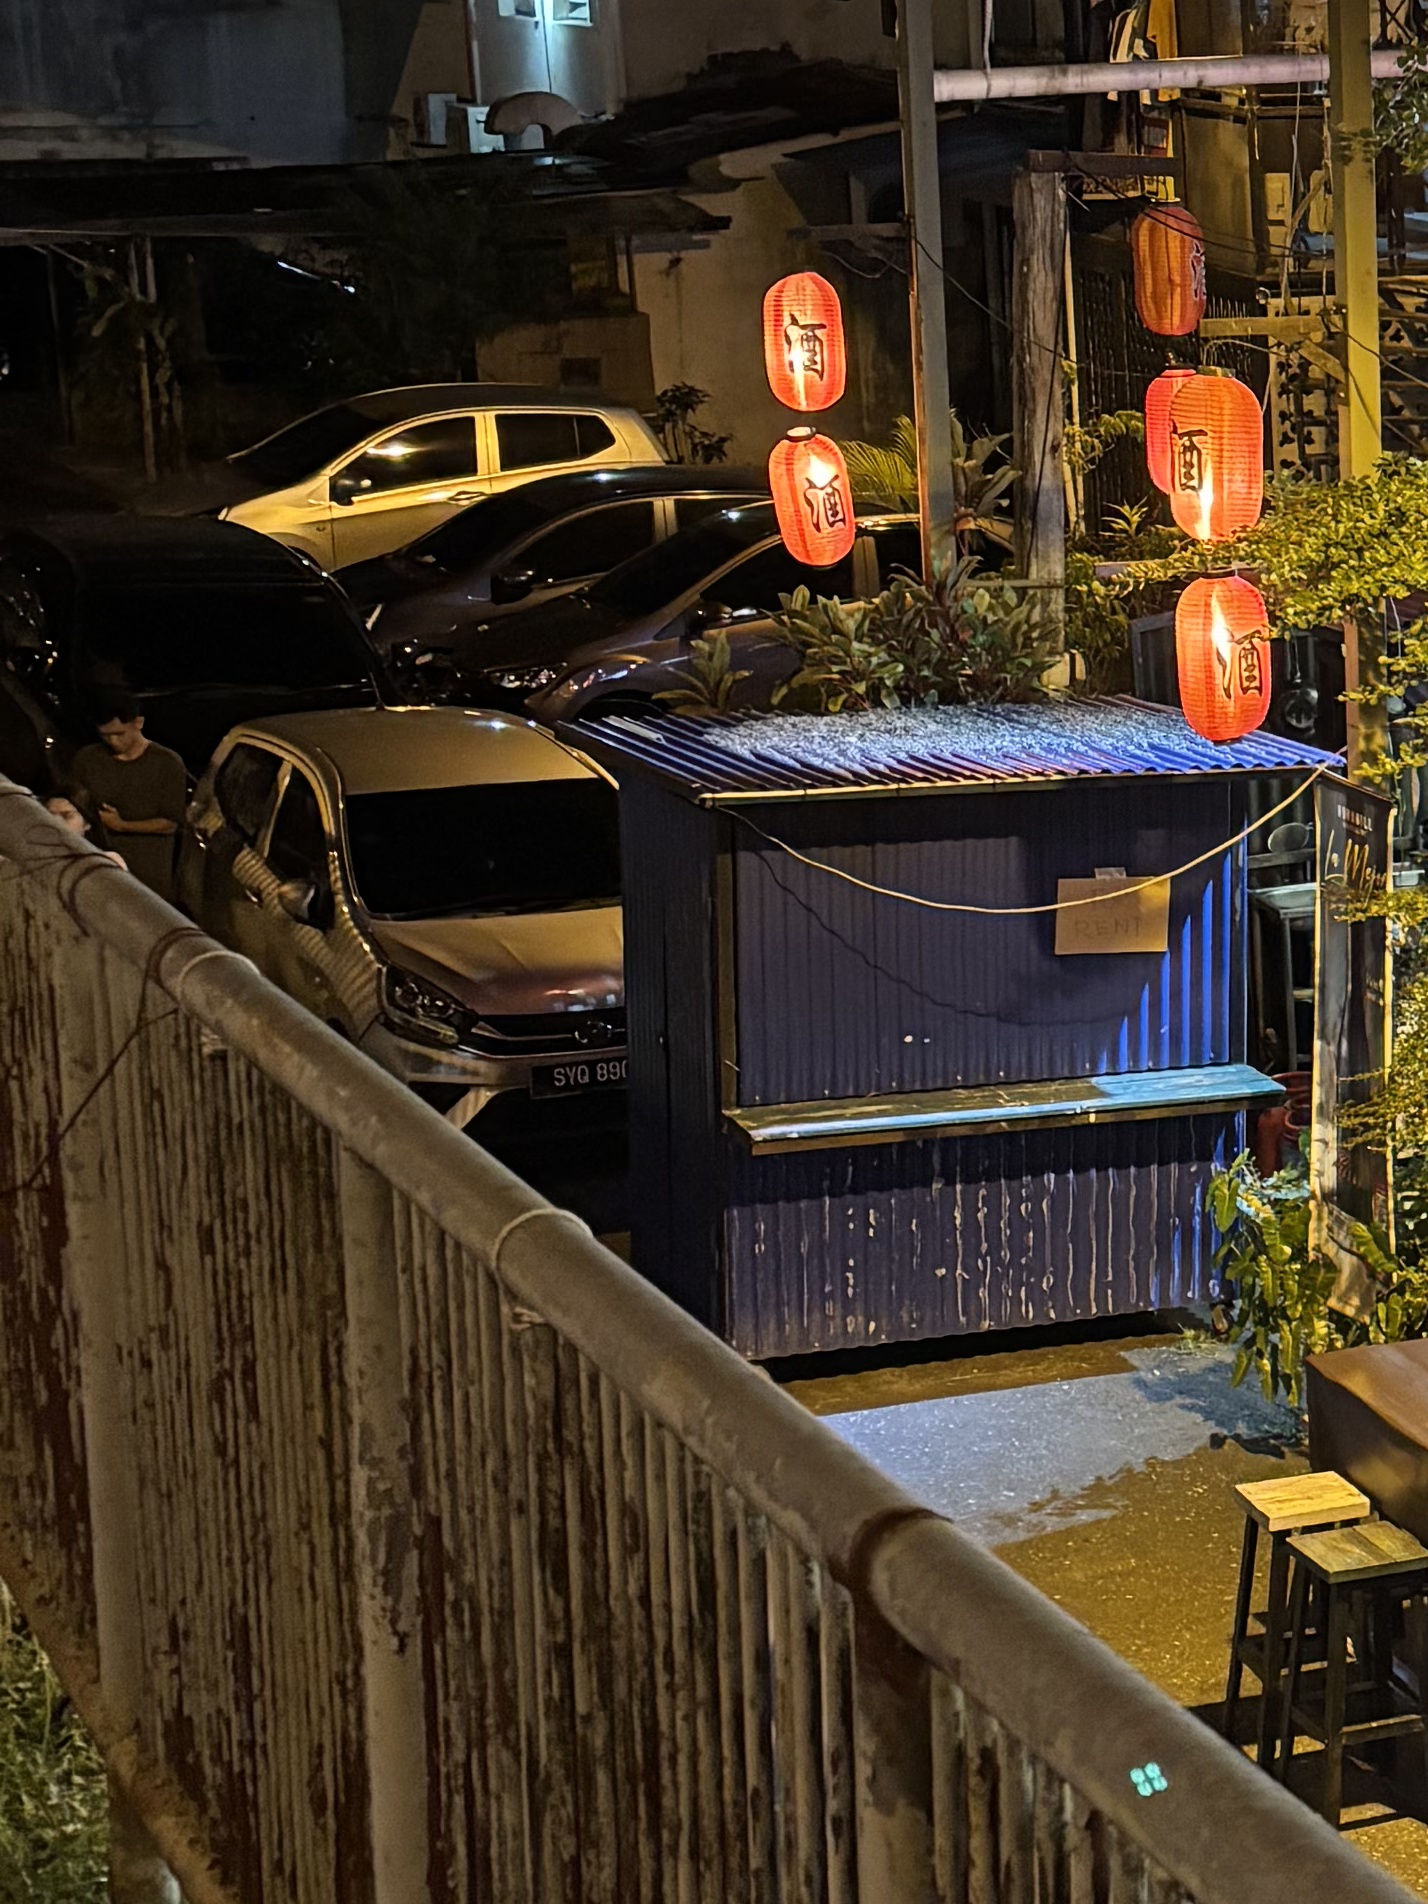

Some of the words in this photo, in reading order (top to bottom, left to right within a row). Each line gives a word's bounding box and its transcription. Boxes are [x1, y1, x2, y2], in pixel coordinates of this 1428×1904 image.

[784, 312, 827, 382] 酒
[804, 474, 847, 534] 酒
[1216, 628, 1264, 701] 酒
[553, 1064, 590, 1087] SYQ
